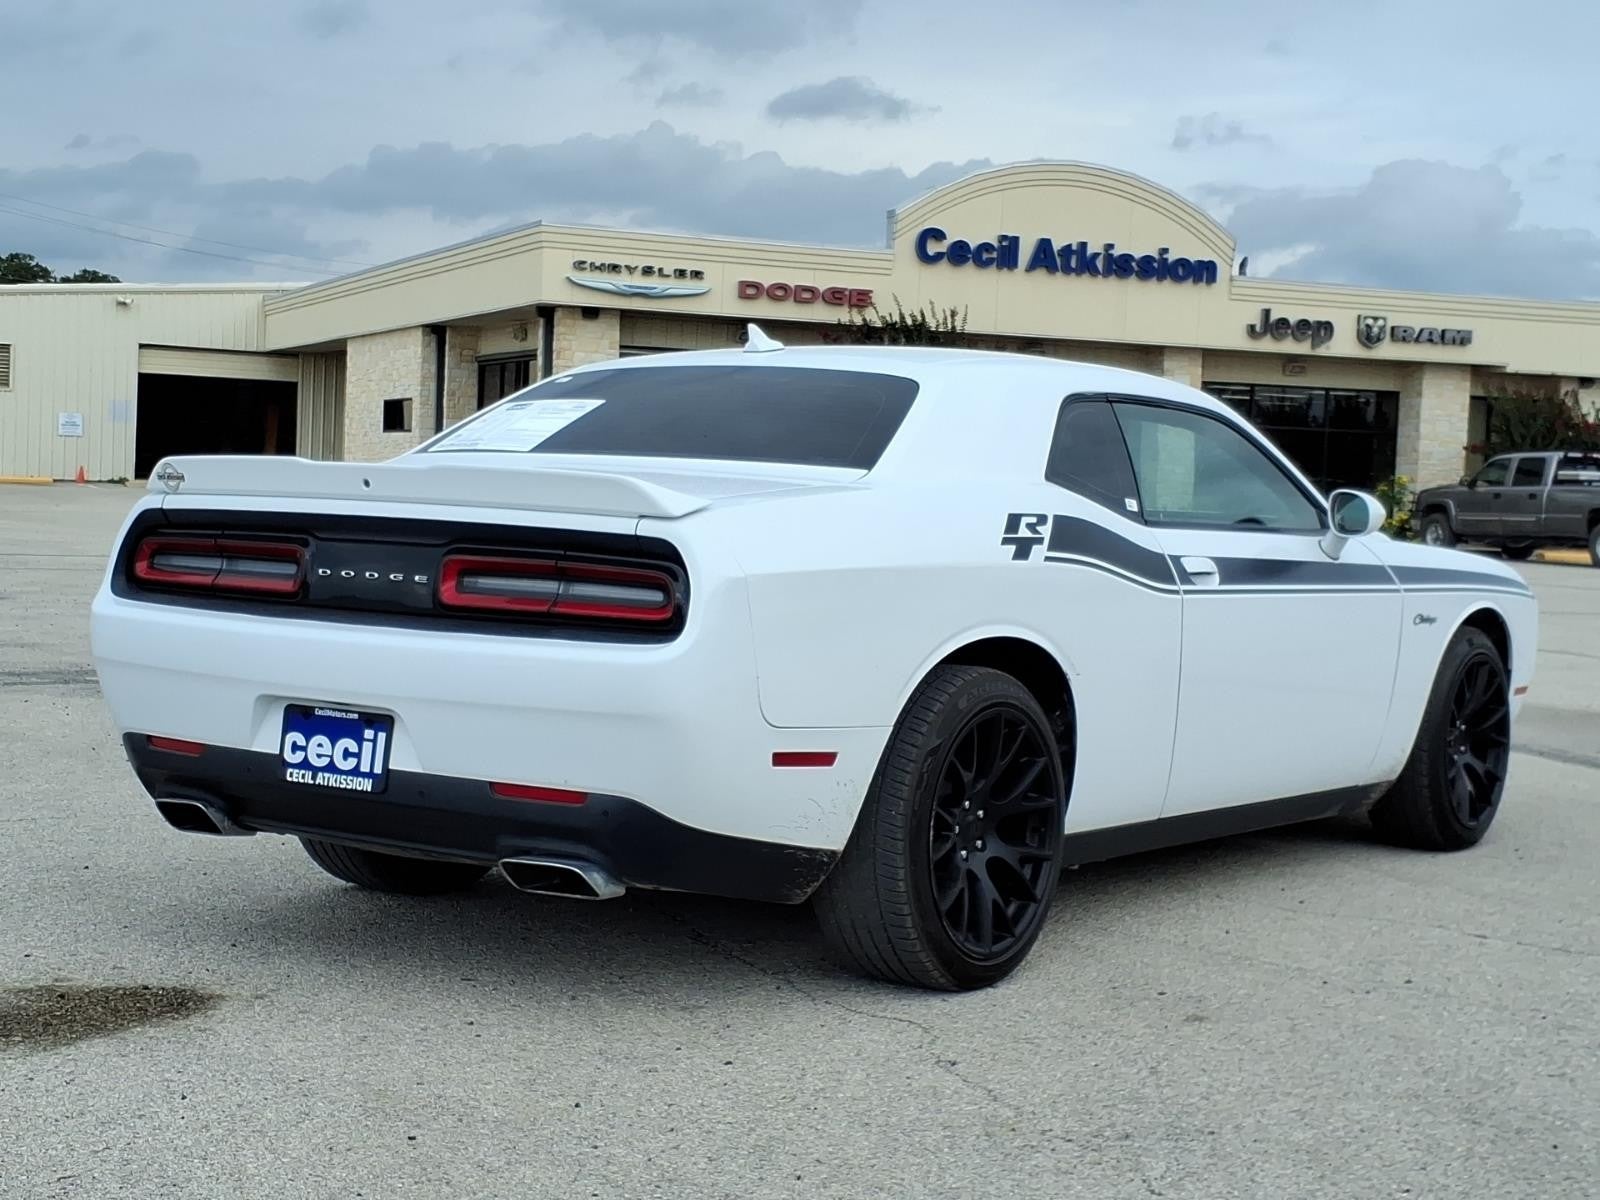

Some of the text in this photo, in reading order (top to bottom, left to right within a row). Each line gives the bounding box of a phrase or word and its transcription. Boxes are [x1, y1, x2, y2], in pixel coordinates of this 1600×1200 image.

[915, 227, 1217, 286] Cecil Atkission
[572, 259, 706, 281] CHRYSLER
[737, 280, 874, 308] DODGE
[1246, 308, 1335, 350] Jeep
[1390, 325, 1473, 346] RAM
[318, 568, 429, 583] DODGE
[283, 728, 387, 775] cecil
[286, 768, 373, 792] CECIL ATKISSION
